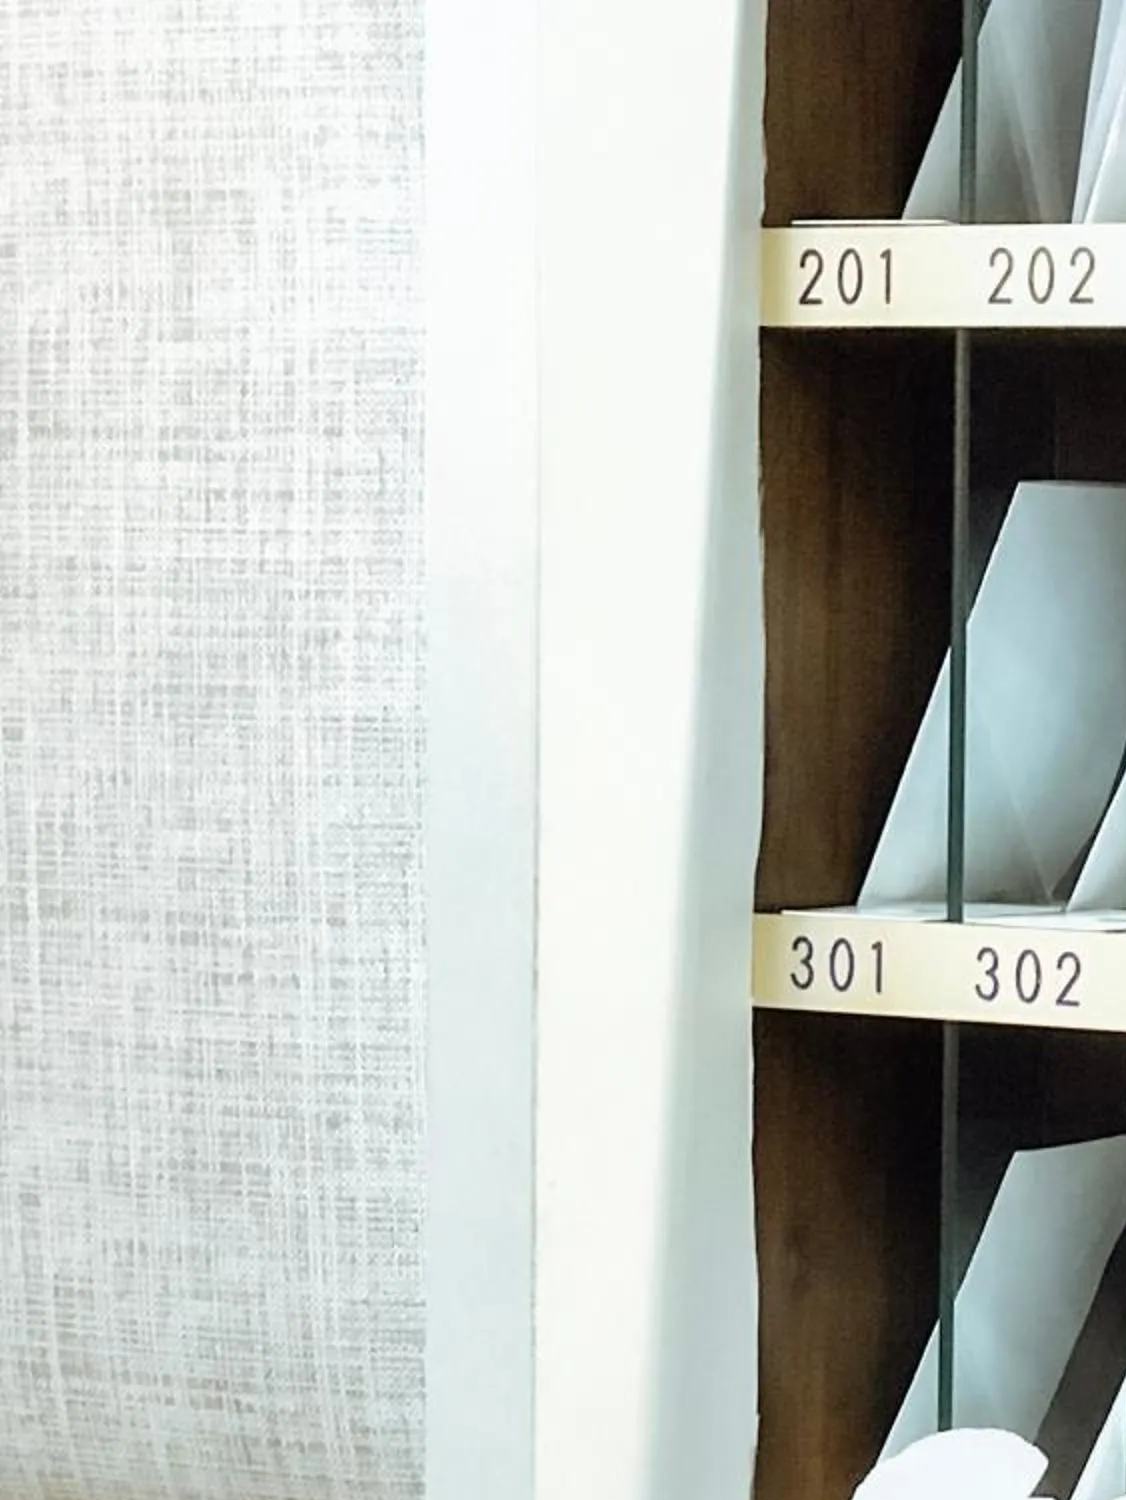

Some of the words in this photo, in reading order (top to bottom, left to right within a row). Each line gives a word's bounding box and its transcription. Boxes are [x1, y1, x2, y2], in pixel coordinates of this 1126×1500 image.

[798, 248, 891, 305] 201
[988, 247, 1095, 304] 202
[790, 936, 883, 994] 301
[975, 947, 1082, 1007] 302
